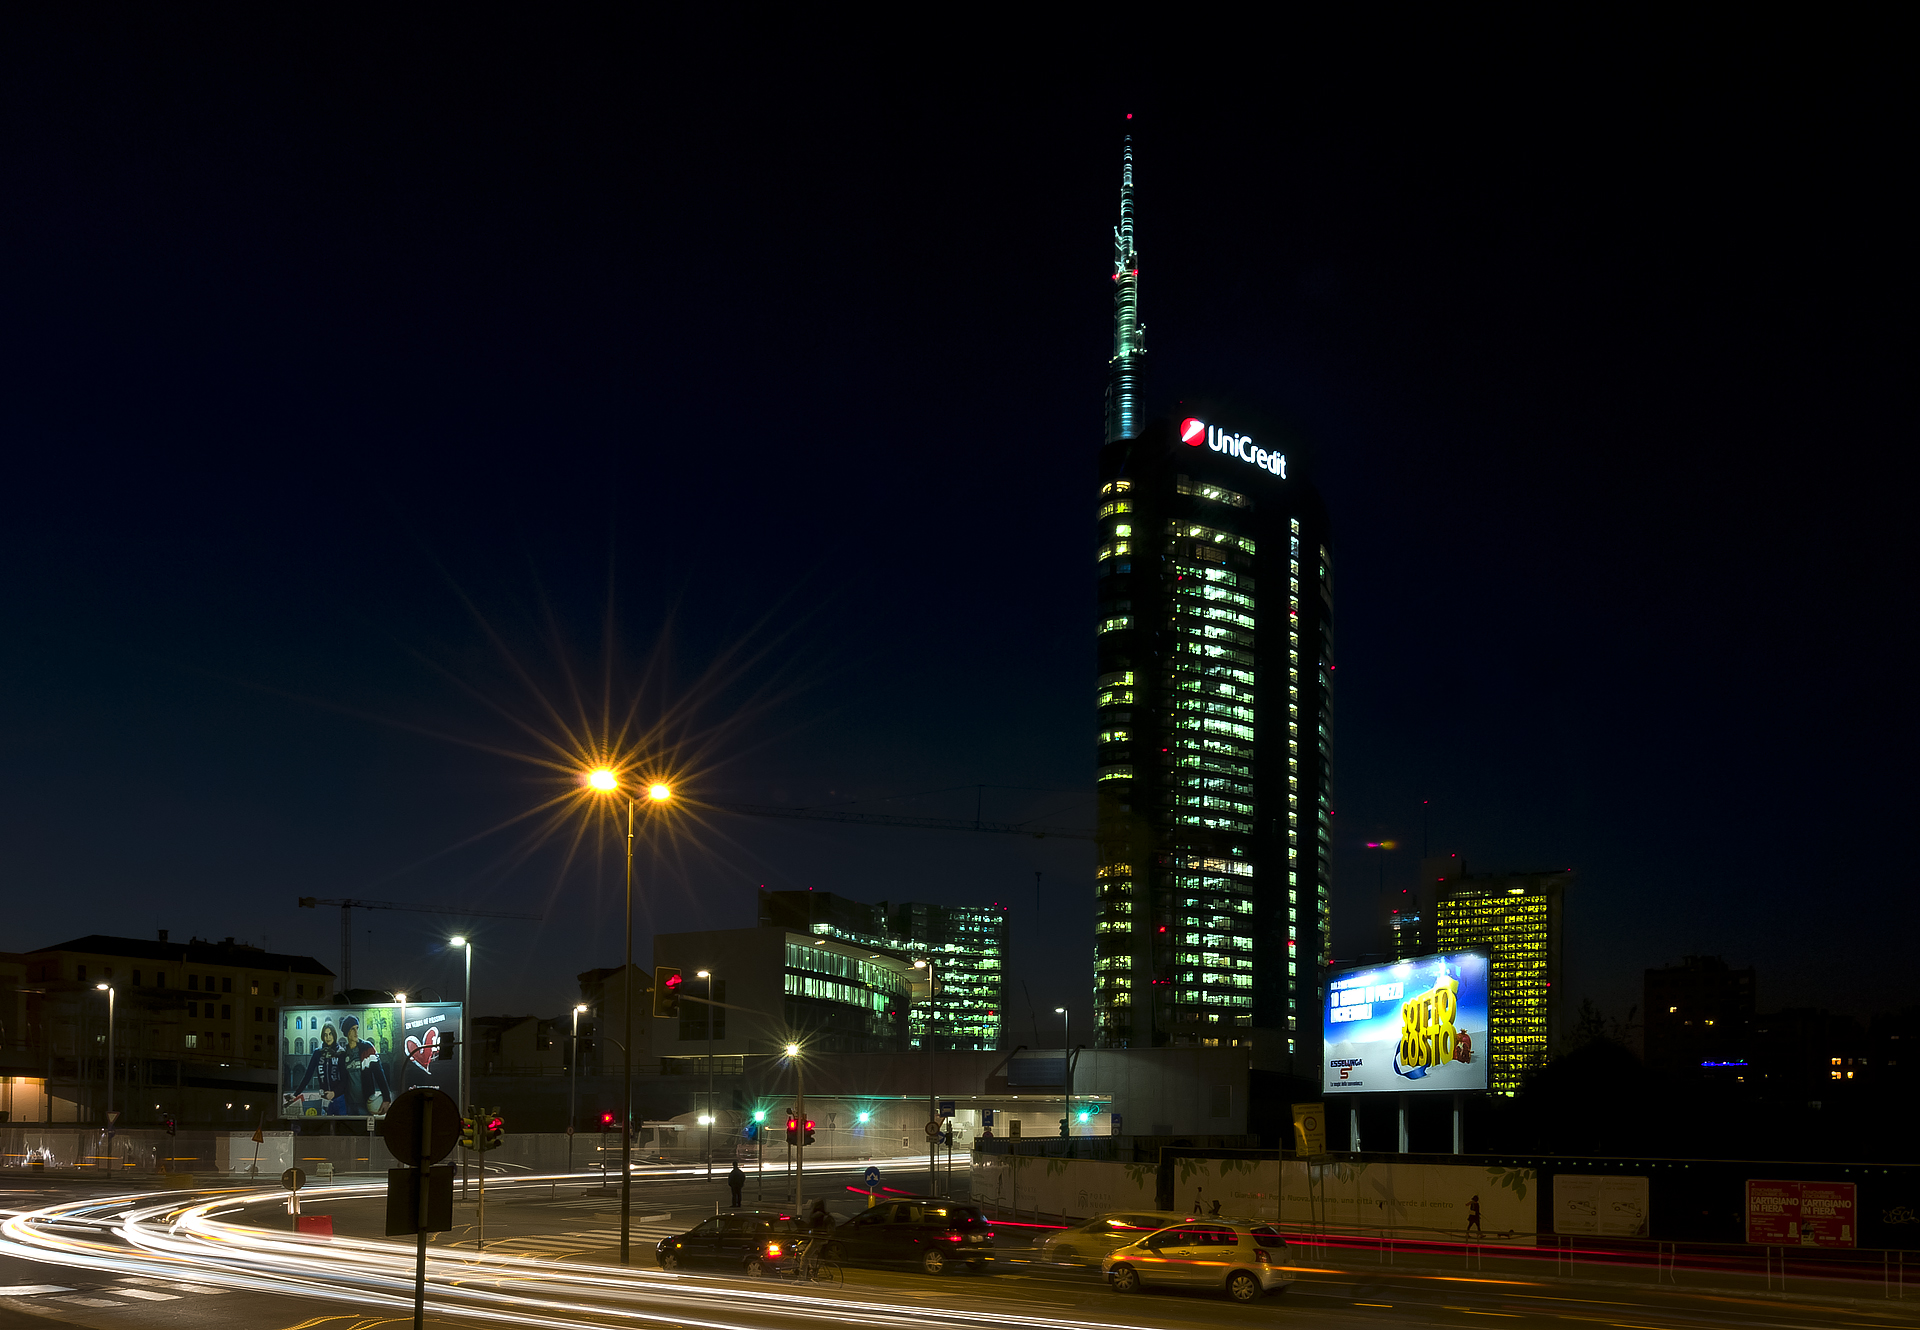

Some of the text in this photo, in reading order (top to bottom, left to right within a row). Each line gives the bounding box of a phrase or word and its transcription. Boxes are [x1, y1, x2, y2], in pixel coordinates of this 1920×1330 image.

[1208, 424, 1287, 480] UniCredit
[1402, 985, 1458, 1034] SOTTO
[1400, 1022, 1456, 1068] COSTO
[1330, 1058, 1363, 1068] ESSELUNGA
[1089, 1193, 1112, 1201] PORTA
[1269, 1193, 1286, 1201] Pora
[1357, 1196, 1373, 1205] città
[1430, 1201, 1454, 1209] centro
[1751, 1196, 1800, 1206] L'ARTIGIANO
[1802, 1198, 1852, 1208] L'ARTIGIANO
[1751, 1204, 1784, 1213] IN FIERA
[1801, 1206, 1811, 1215] IN
[1812, 1207, 1837, 1216] FIERA
